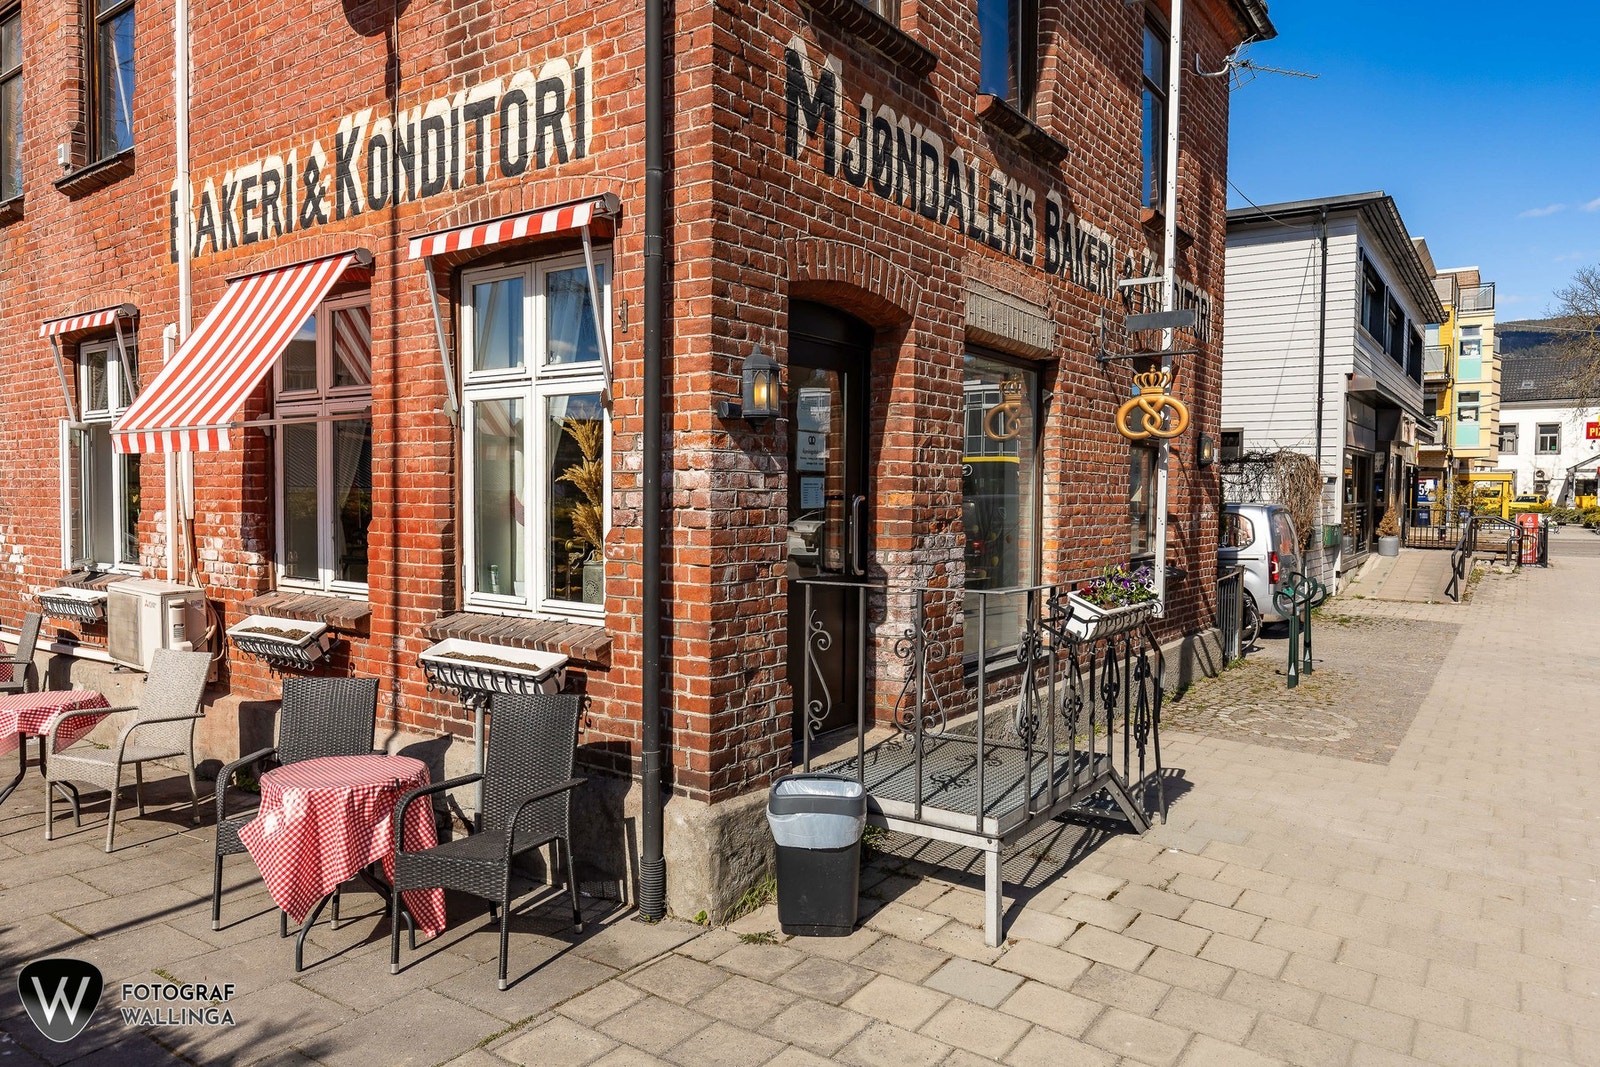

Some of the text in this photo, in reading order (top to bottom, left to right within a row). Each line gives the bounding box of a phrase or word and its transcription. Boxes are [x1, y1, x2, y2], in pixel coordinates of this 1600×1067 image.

[334, 48, 592, 221] KONDITORI
[785, 36, 1036, 266] MJØNDALENS
[1045, 189, 1117, 299] BAKERI
[1139, 246, 1213, 344] KOITORI
